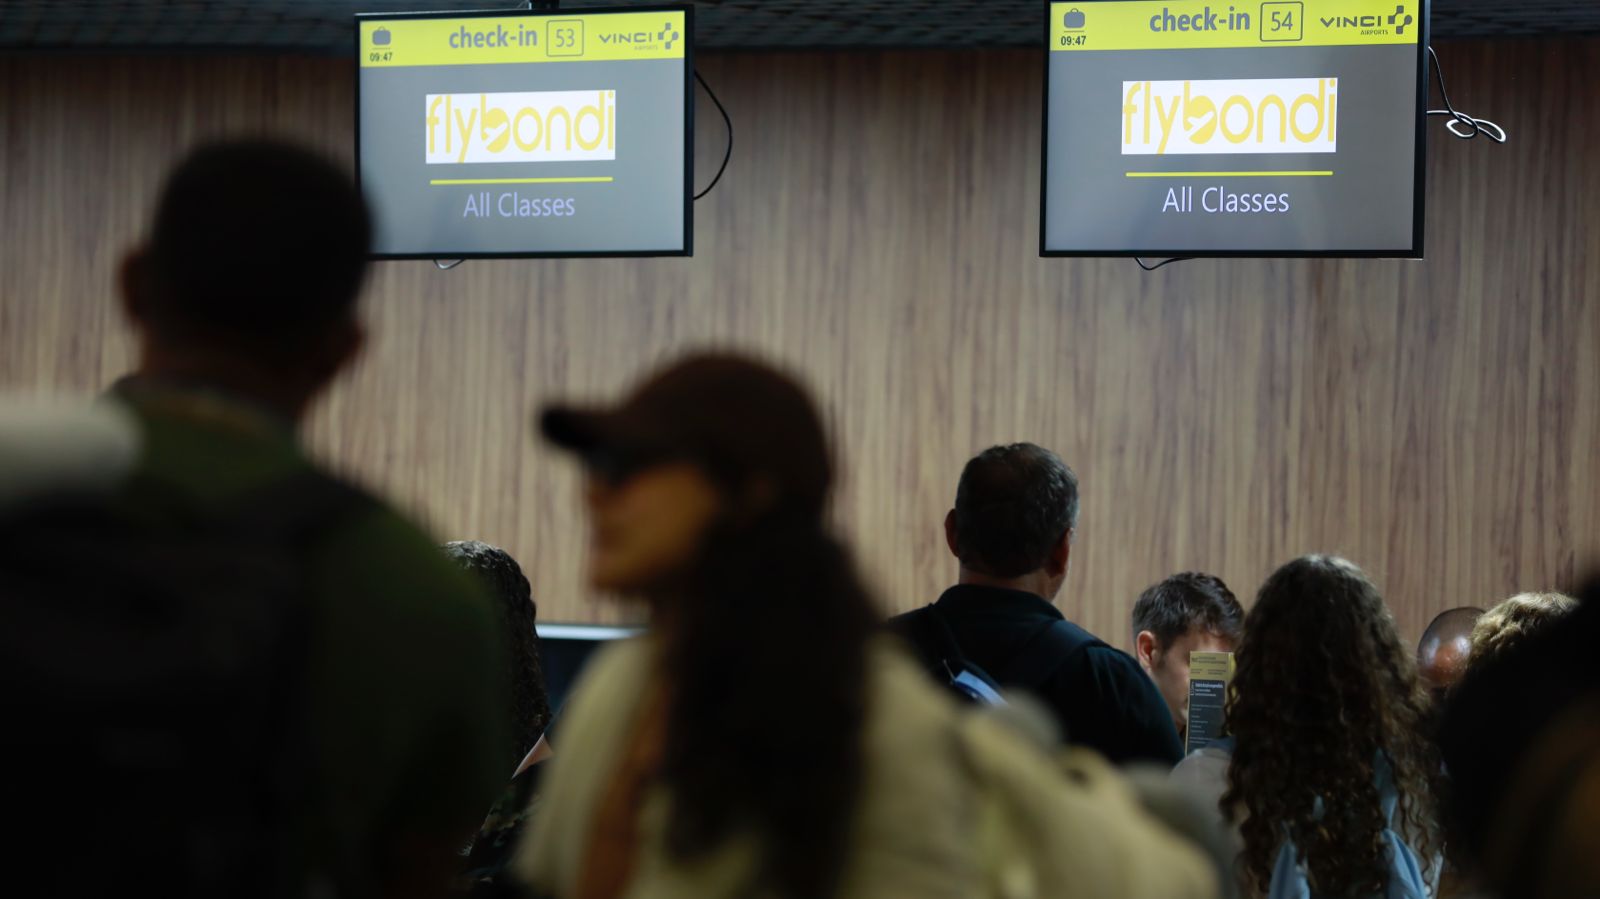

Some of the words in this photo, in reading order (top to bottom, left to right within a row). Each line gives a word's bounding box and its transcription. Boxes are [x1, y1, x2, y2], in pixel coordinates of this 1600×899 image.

[1149, 6, 1250, 33] check-in
[1270, 11, 1293, 32] 54
[1319, 14, 1381, 29] VINCI
[449, 24, 538, 50] check-in
[555, 28, 575, 48] 53
[598, 31, 653, 45] VINCI
[1060, 35, 1087, 46] 09:47
[1360, 28, 1388, 36] AIRPORTS
[369, 52, 393, 63] 09:47
[426, 90, 615, 163] flybondi
[1122, 78, 1337, 155] flybondi
[463, 192, 490, 218] All
[497, 192, 576, 217] Classes
[1162, 186, 1192, 213] All
[1201, 186, 1290, 213] Classes
